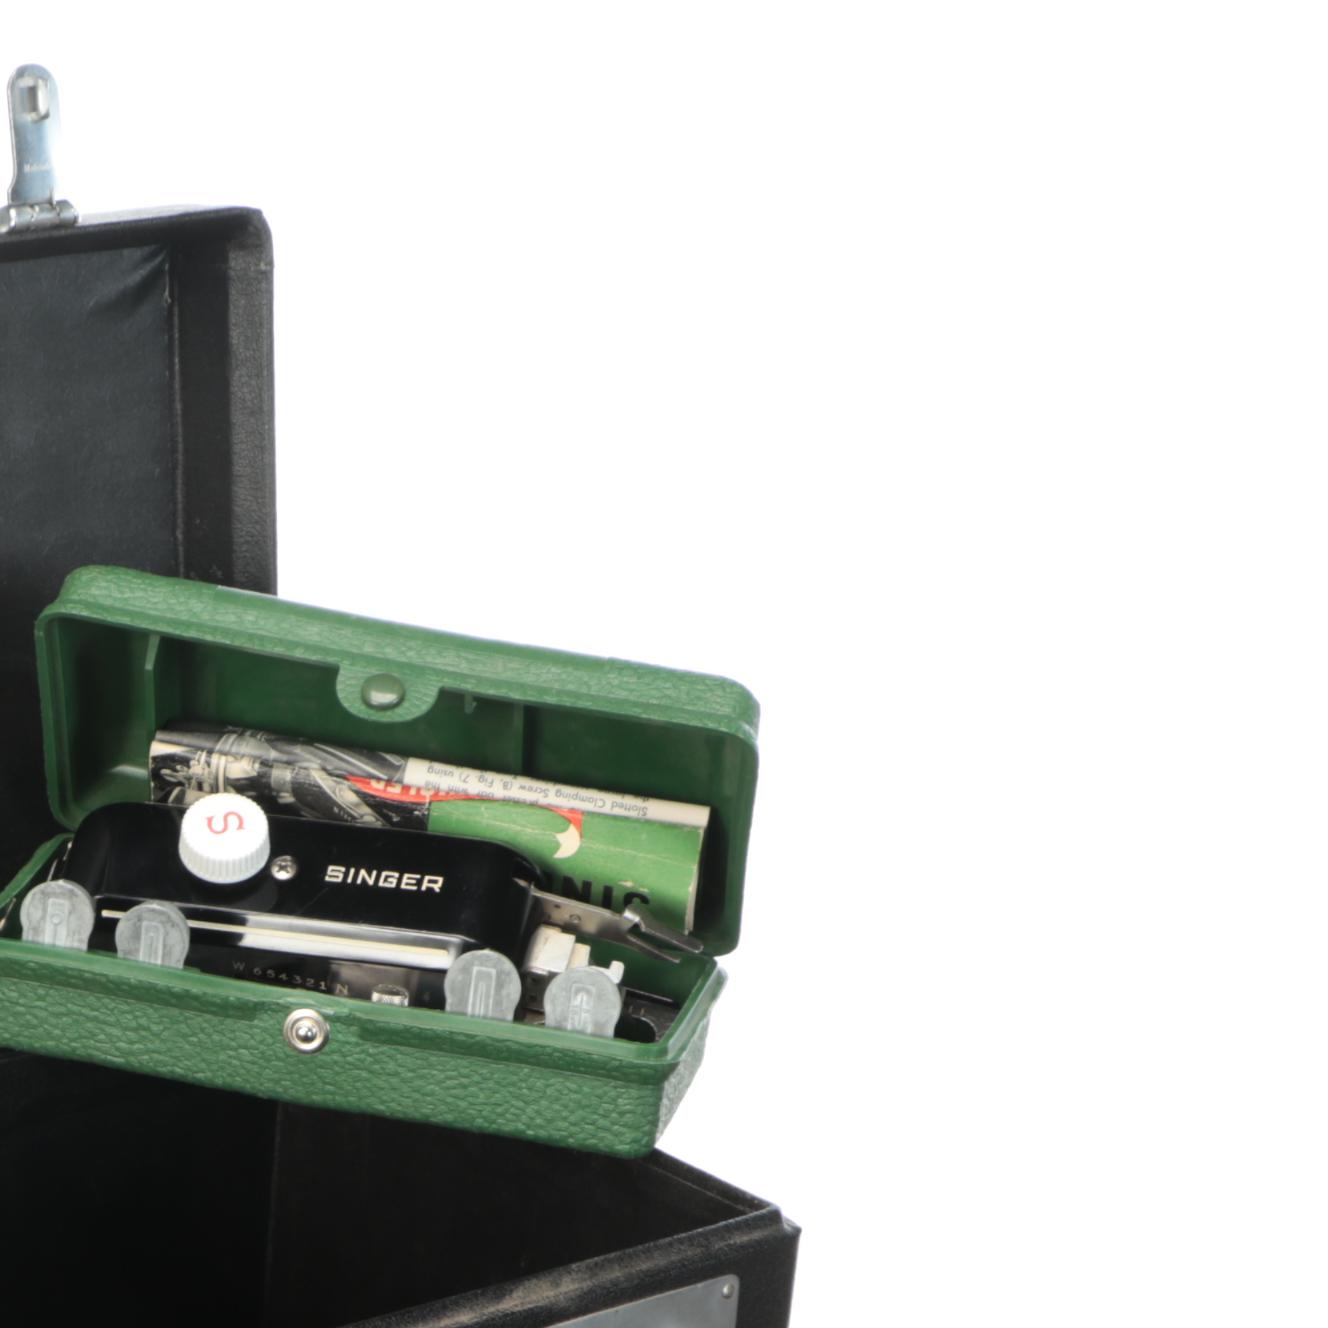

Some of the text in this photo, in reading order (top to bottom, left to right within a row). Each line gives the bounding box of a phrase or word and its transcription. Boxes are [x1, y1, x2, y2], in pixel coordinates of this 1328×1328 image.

[426, 764, 455, 778] using
[518, 784, 551, 799] Screw
[554, 788, 607, 808] Clamping
[610, 800, 649, 817] Slotted
[205, 811, 246, 835] S
[324, 864, 445, 893] SINGER
[335, 983, 349, 996] N
